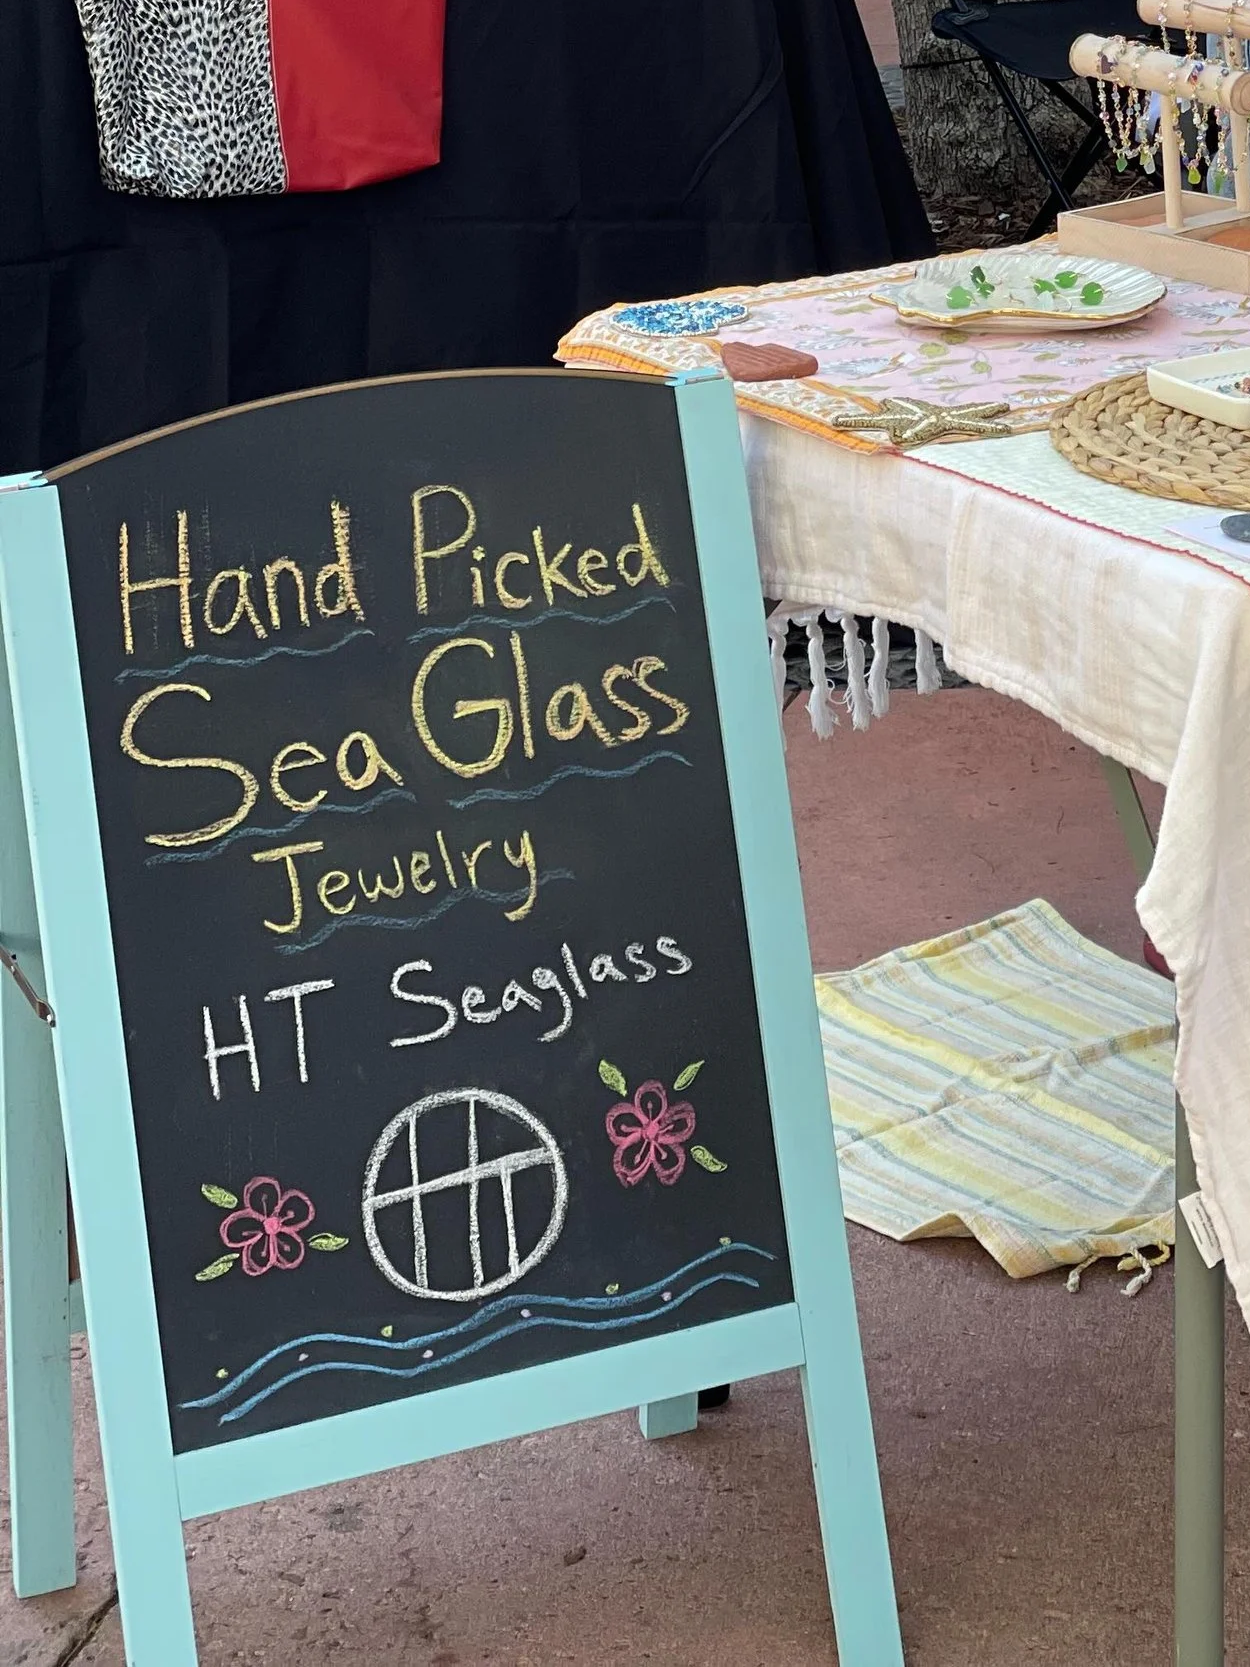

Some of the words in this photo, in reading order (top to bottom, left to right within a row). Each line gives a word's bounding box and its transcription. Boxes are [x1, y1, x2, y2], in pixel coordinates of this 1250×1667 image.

[119, 496, 366, 655] Hand
[411, 485, 672, 615] Picked
[120, 683, 404, 847] Sea
[411, 630, 690, 778] Glass
[251, 830, 538, 934] Jewelry
[202, 978, 336, 1100] HT
[389, 935, 693, 1043] Seaglass
